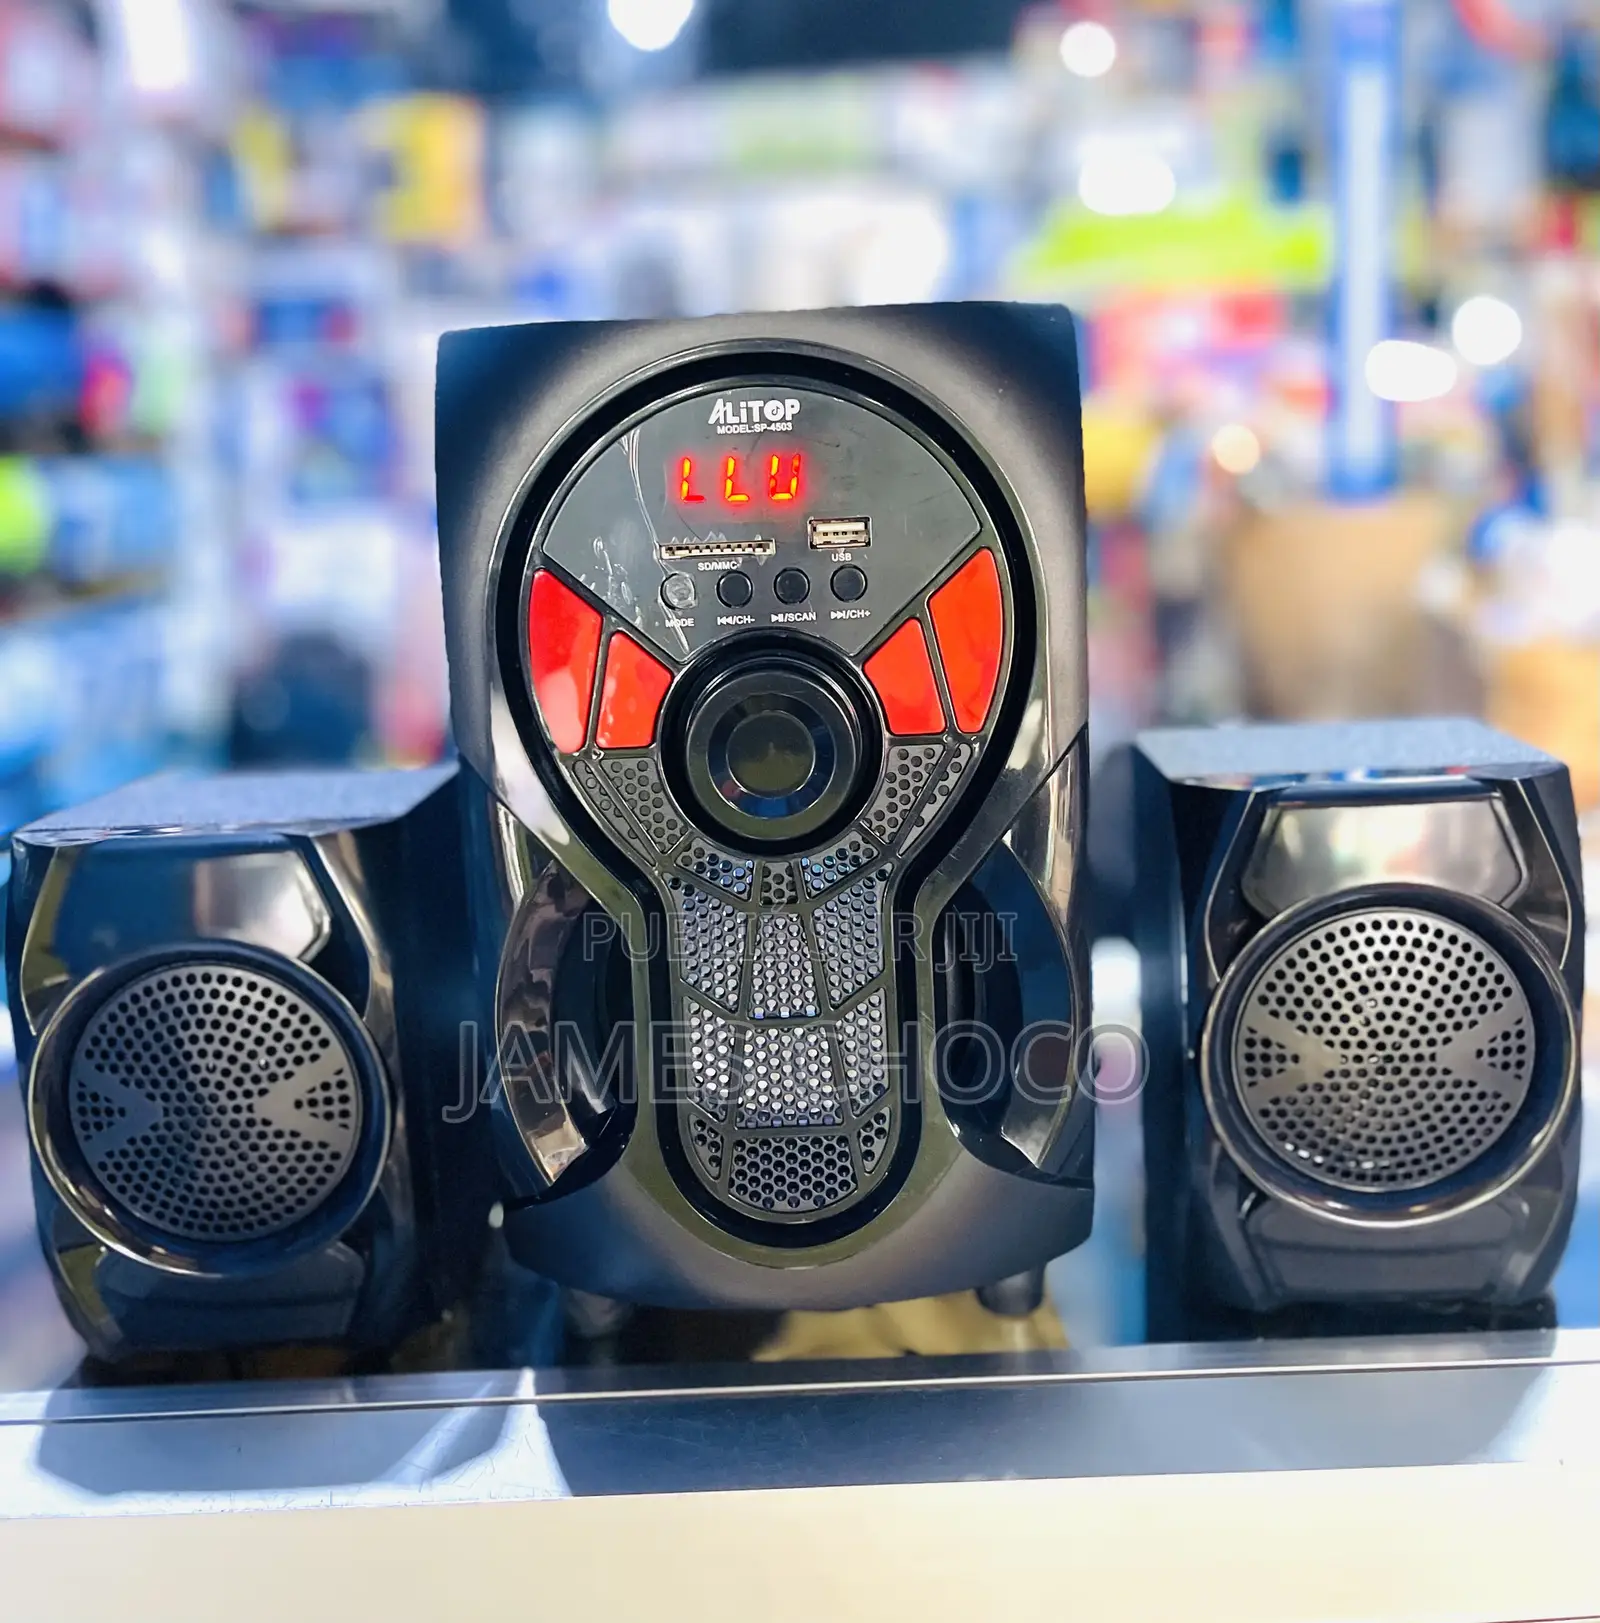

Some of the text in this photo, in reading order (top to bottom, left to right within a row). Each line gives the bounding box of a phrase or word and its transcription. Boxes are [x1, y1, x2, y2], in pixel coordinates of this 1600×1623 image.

[831, 552, 852, 562] USB
[697, 561, 738, 571] SD/MMC
[665, 617, 694, 628] MODE
